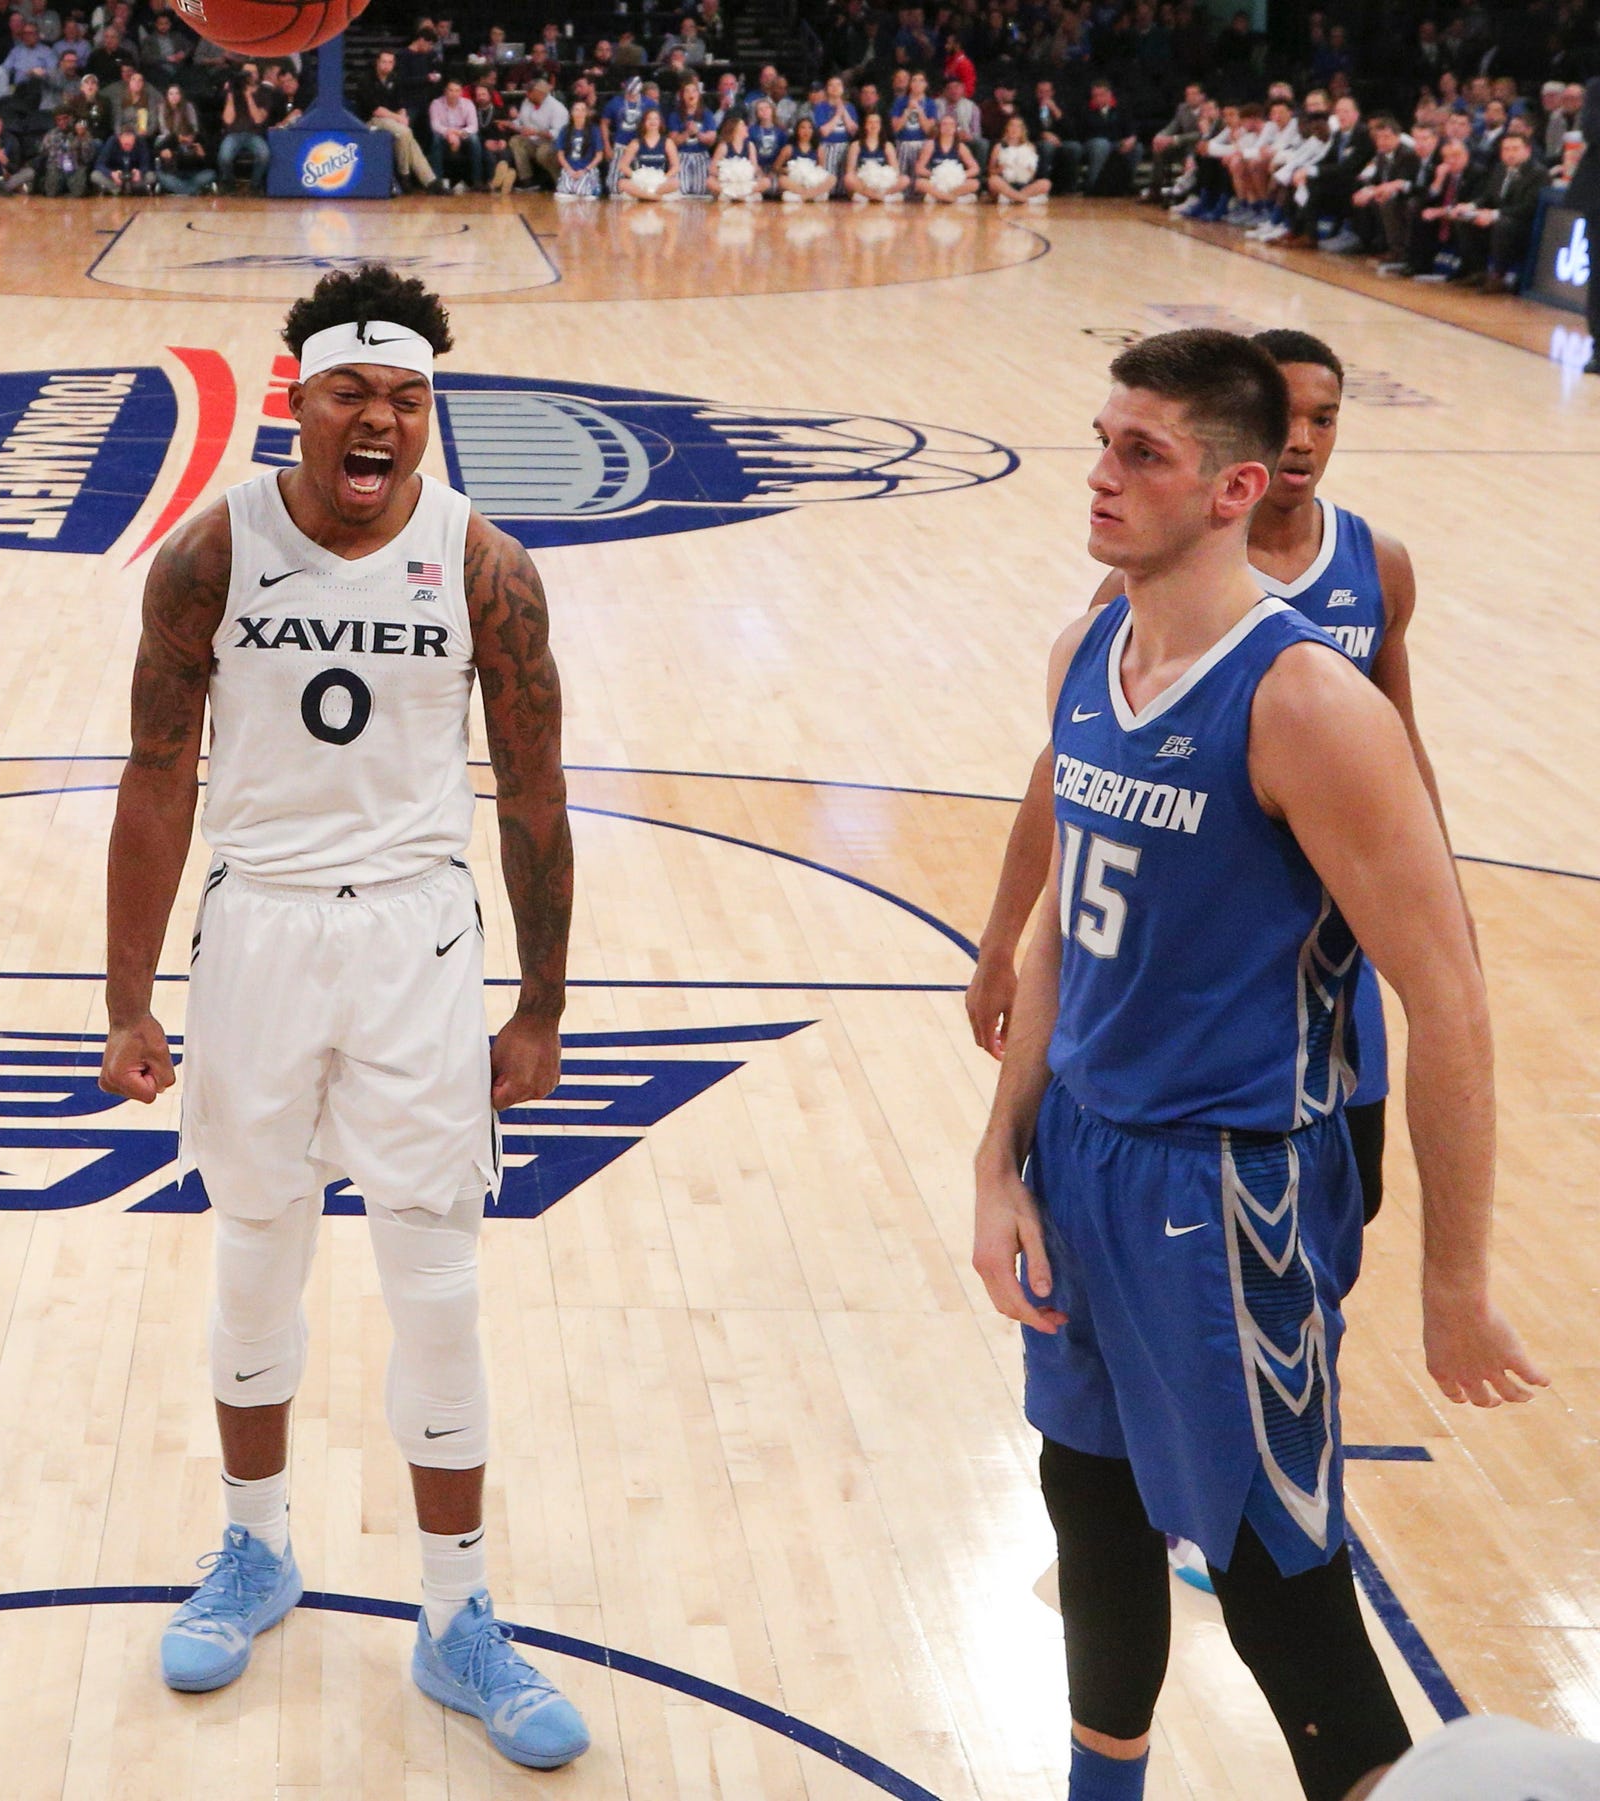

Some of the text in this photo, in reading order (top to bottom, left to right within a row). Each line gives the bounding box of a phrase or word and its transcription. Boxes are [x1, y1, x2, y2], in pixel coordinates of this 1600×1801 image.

[235, 617, 449, 657] XAVIER
[301, 667, 373, 746] 0
[1160, 744, 1197, 756] EAST
[1165, 735, 1193, 745] BIG
[1053, 753, 1208, 834] CREIGHTON
[1060, 821, 1142, 959] 15
